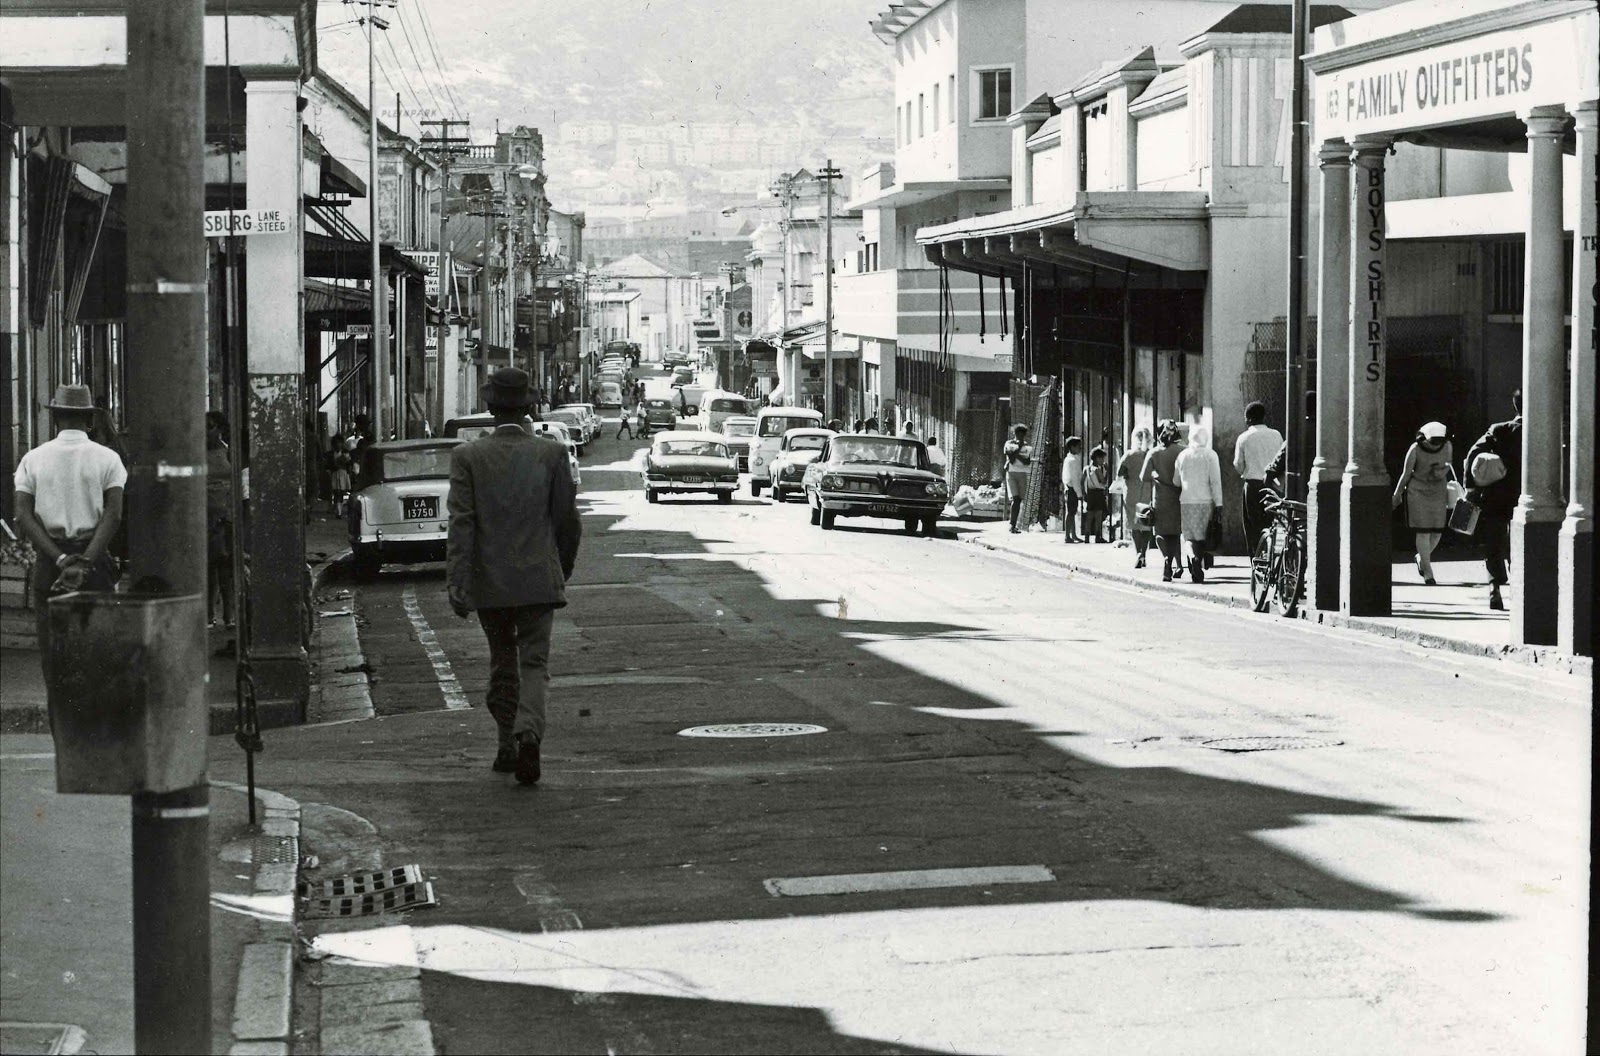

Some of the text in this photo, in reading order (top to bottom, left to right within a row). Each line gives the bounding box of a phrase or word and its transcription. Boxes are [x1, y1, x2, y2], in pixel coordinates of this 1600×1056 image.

[1347, 69, 1408, 123] FAMILY
[1416, 42, 1533, 110] OUTFITTERS
[258, 211, 280, 222] LANE
[1368, 167, 1382, 252] BOYS
[205, 214, 252, 232] SBURG
[1366, 259, 1382, 383] SHIRTS
[413, 499, 426, 508] CA
[407, 508, 434, 518] 13750
